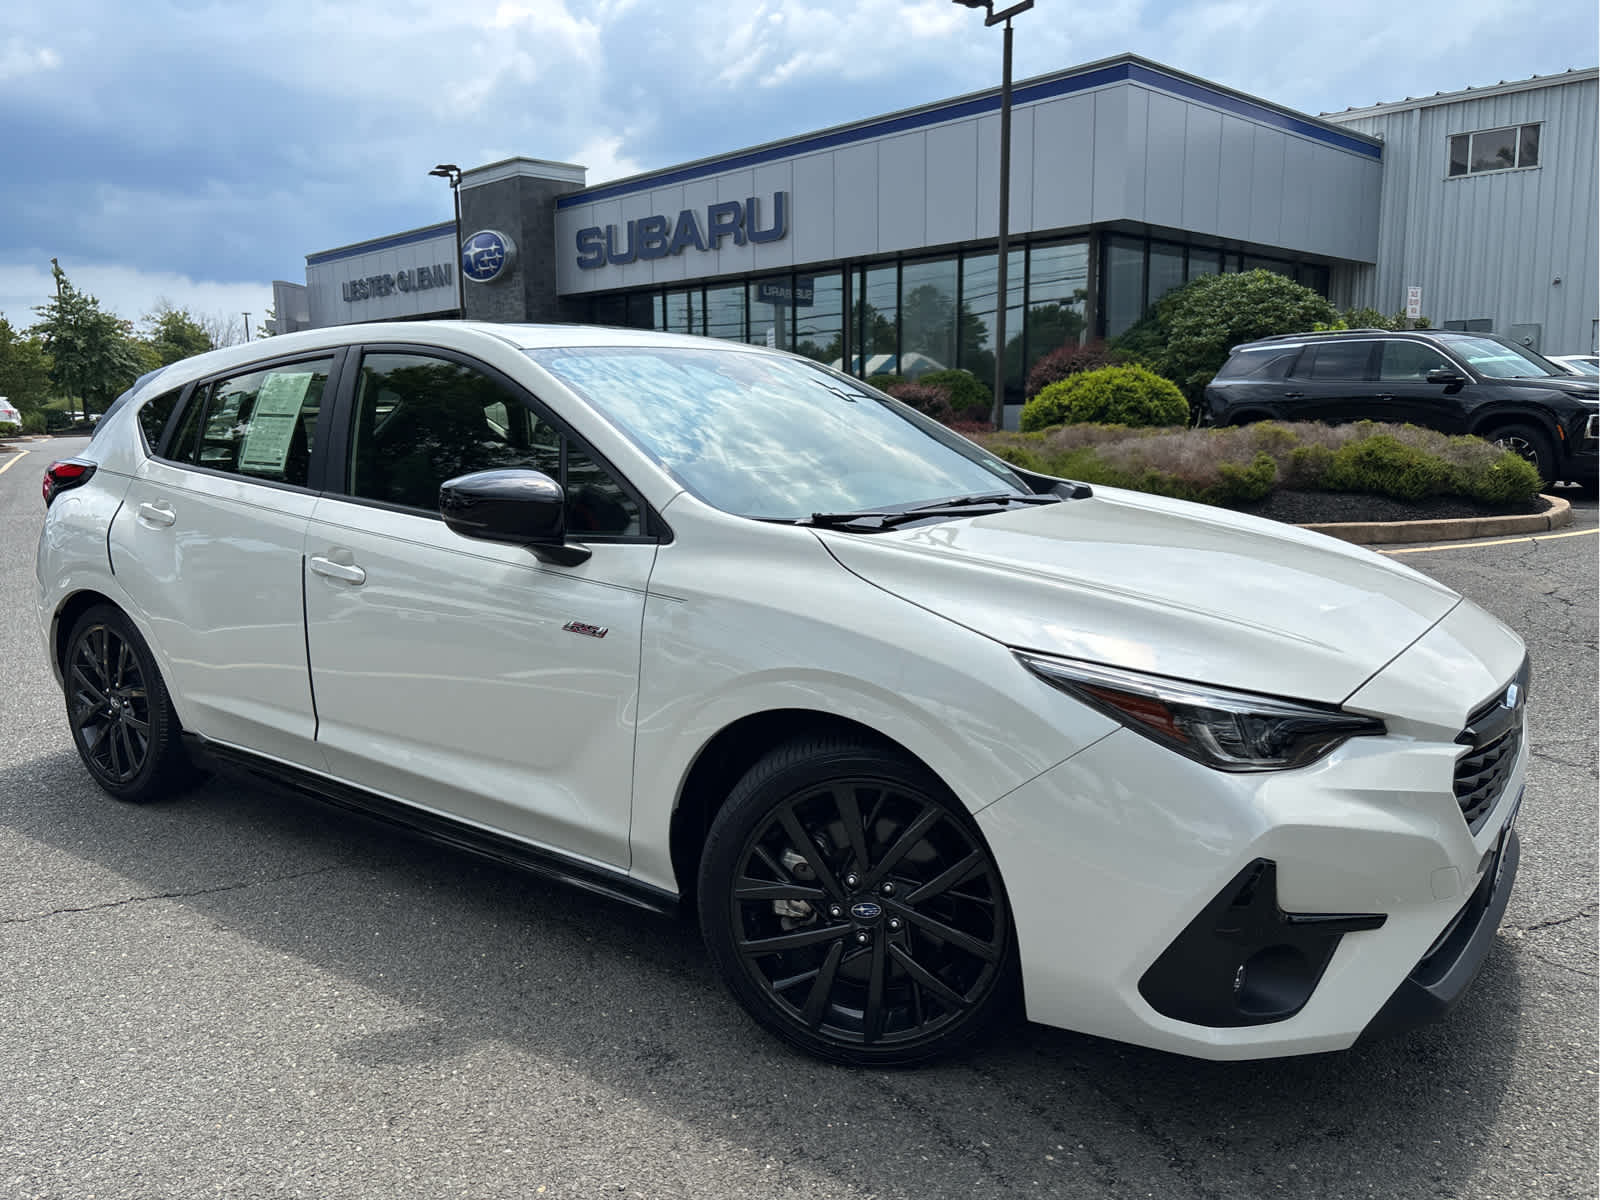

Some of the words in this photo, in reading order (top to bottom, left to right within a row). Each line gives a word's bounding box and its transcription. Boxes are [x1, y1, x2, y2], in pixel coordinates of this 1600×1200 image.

[576, 191, 788, 270] SUBARU
[342, 273, 396, 302] LESTER
[397, 263, 453, 293] GLENN
